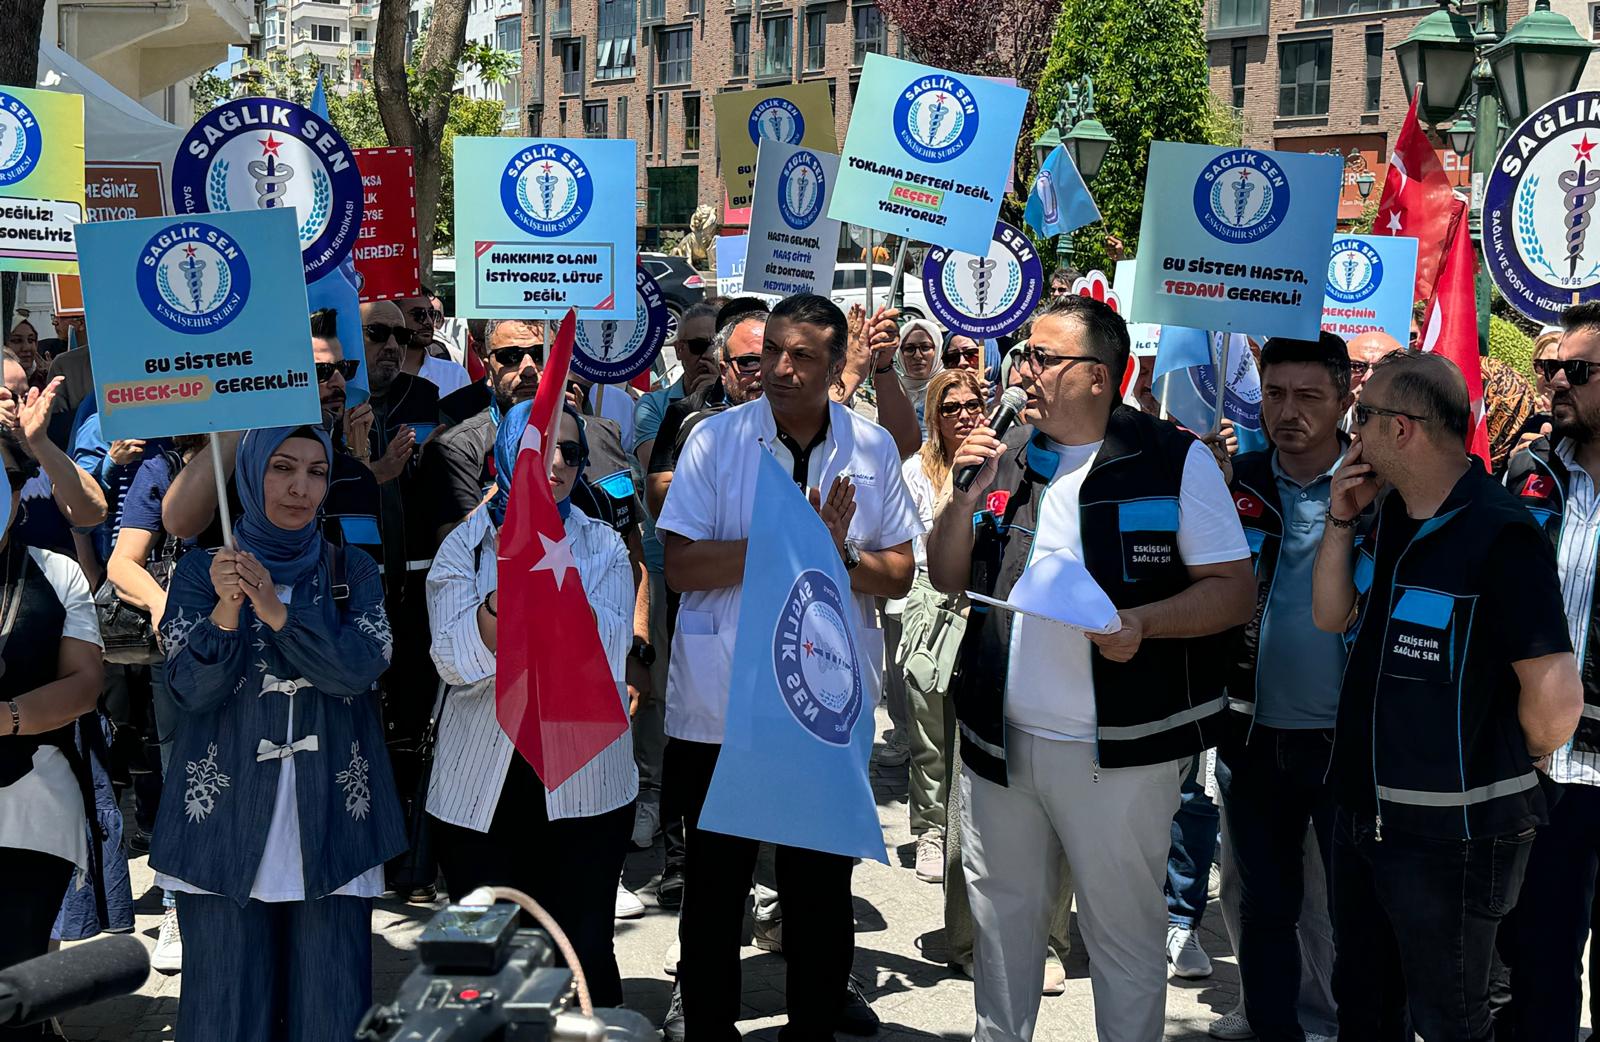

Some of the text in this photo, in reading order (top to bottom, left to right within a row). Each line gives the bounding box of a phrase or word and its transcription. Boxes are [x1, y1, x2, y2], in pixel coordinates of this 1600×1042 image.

[956, 88, 975, 114] SEN
[9, 102, 34, 128] SEN
[189, 104, 350, 173] SAĞLIK SEN
[561, 152, 586, 178] SEN
[738, 165, 751, 174] BU
[1261, 160, 1284, 187] SEN
[848, 156, 994, 203] YOKLAMA DEFTERİ DEĞİL,
[733, 195, 746, 205] BU
[894, 186, 939, 206] REÇETE
[331, 201, 355, 250] SENDİKASI
[878, 200, 948, 226] YAZIYORUZ!
[206, 231, 239, 260] SEN
[355, 243, 405, 260] NEREDE?
[1001, 229, 1033, 263] SEN
[491, 253, 598, 265] HAKKIMIZ OLANI
[1163, 257, 1308, 285] BU SİSTEM HASTA,
[1492, 209, 1573, 313] SAĞLIK VE SOSYAL HİZME
[486, 269, 603, 284] İSTİYORUZ, LÜTUF
[523, 290, 567, 302] DEĞİL!
[637, 272, 662, 308] SEN
[1165, 279, 1302, 306] TEDAVİ GEREKLİ!
[145, 351, 253, 374] BU SİSTEME
[107, 370, 309, 404] CHECK-UP GEREKLİ!!!
[1393, 645, 1440, 662] SAĞLIK SEN
[1398, 634, 1439, 650] ESKİŞEHİR
